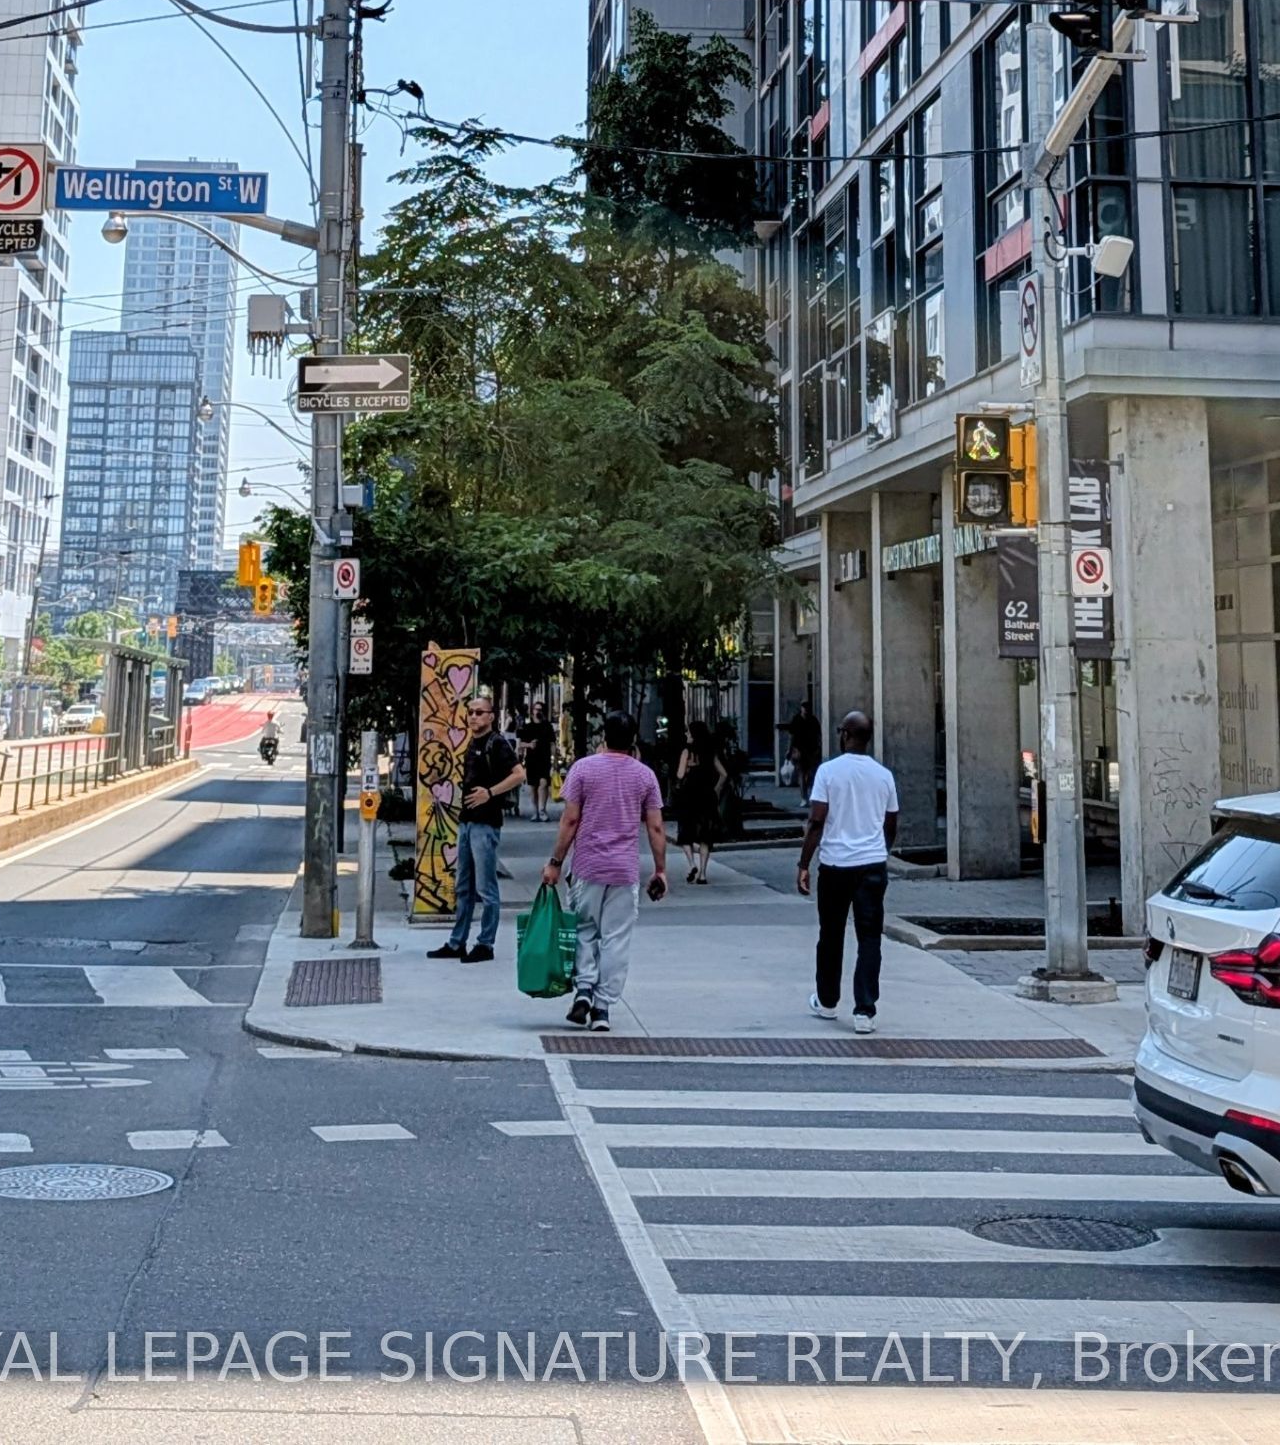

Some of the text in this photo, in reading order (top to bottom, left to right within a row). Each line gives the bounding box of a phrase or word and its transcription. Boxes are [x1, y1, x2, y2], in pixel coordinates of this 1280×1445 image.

[63, 171, 261, 209] Wellington St W
[300, 395, 409, 408] BICYCLES EXCEPTED
[1069, 477, 1102, 522] LAB
[1005, 600, 1028, 618] 62
[1073, 597, 1104, 639] THE
[1005, 620, 1040, 629] Bathurs
[1005, 631, 1034, 641] Street
[1248, 757, 1273, 786] Here
